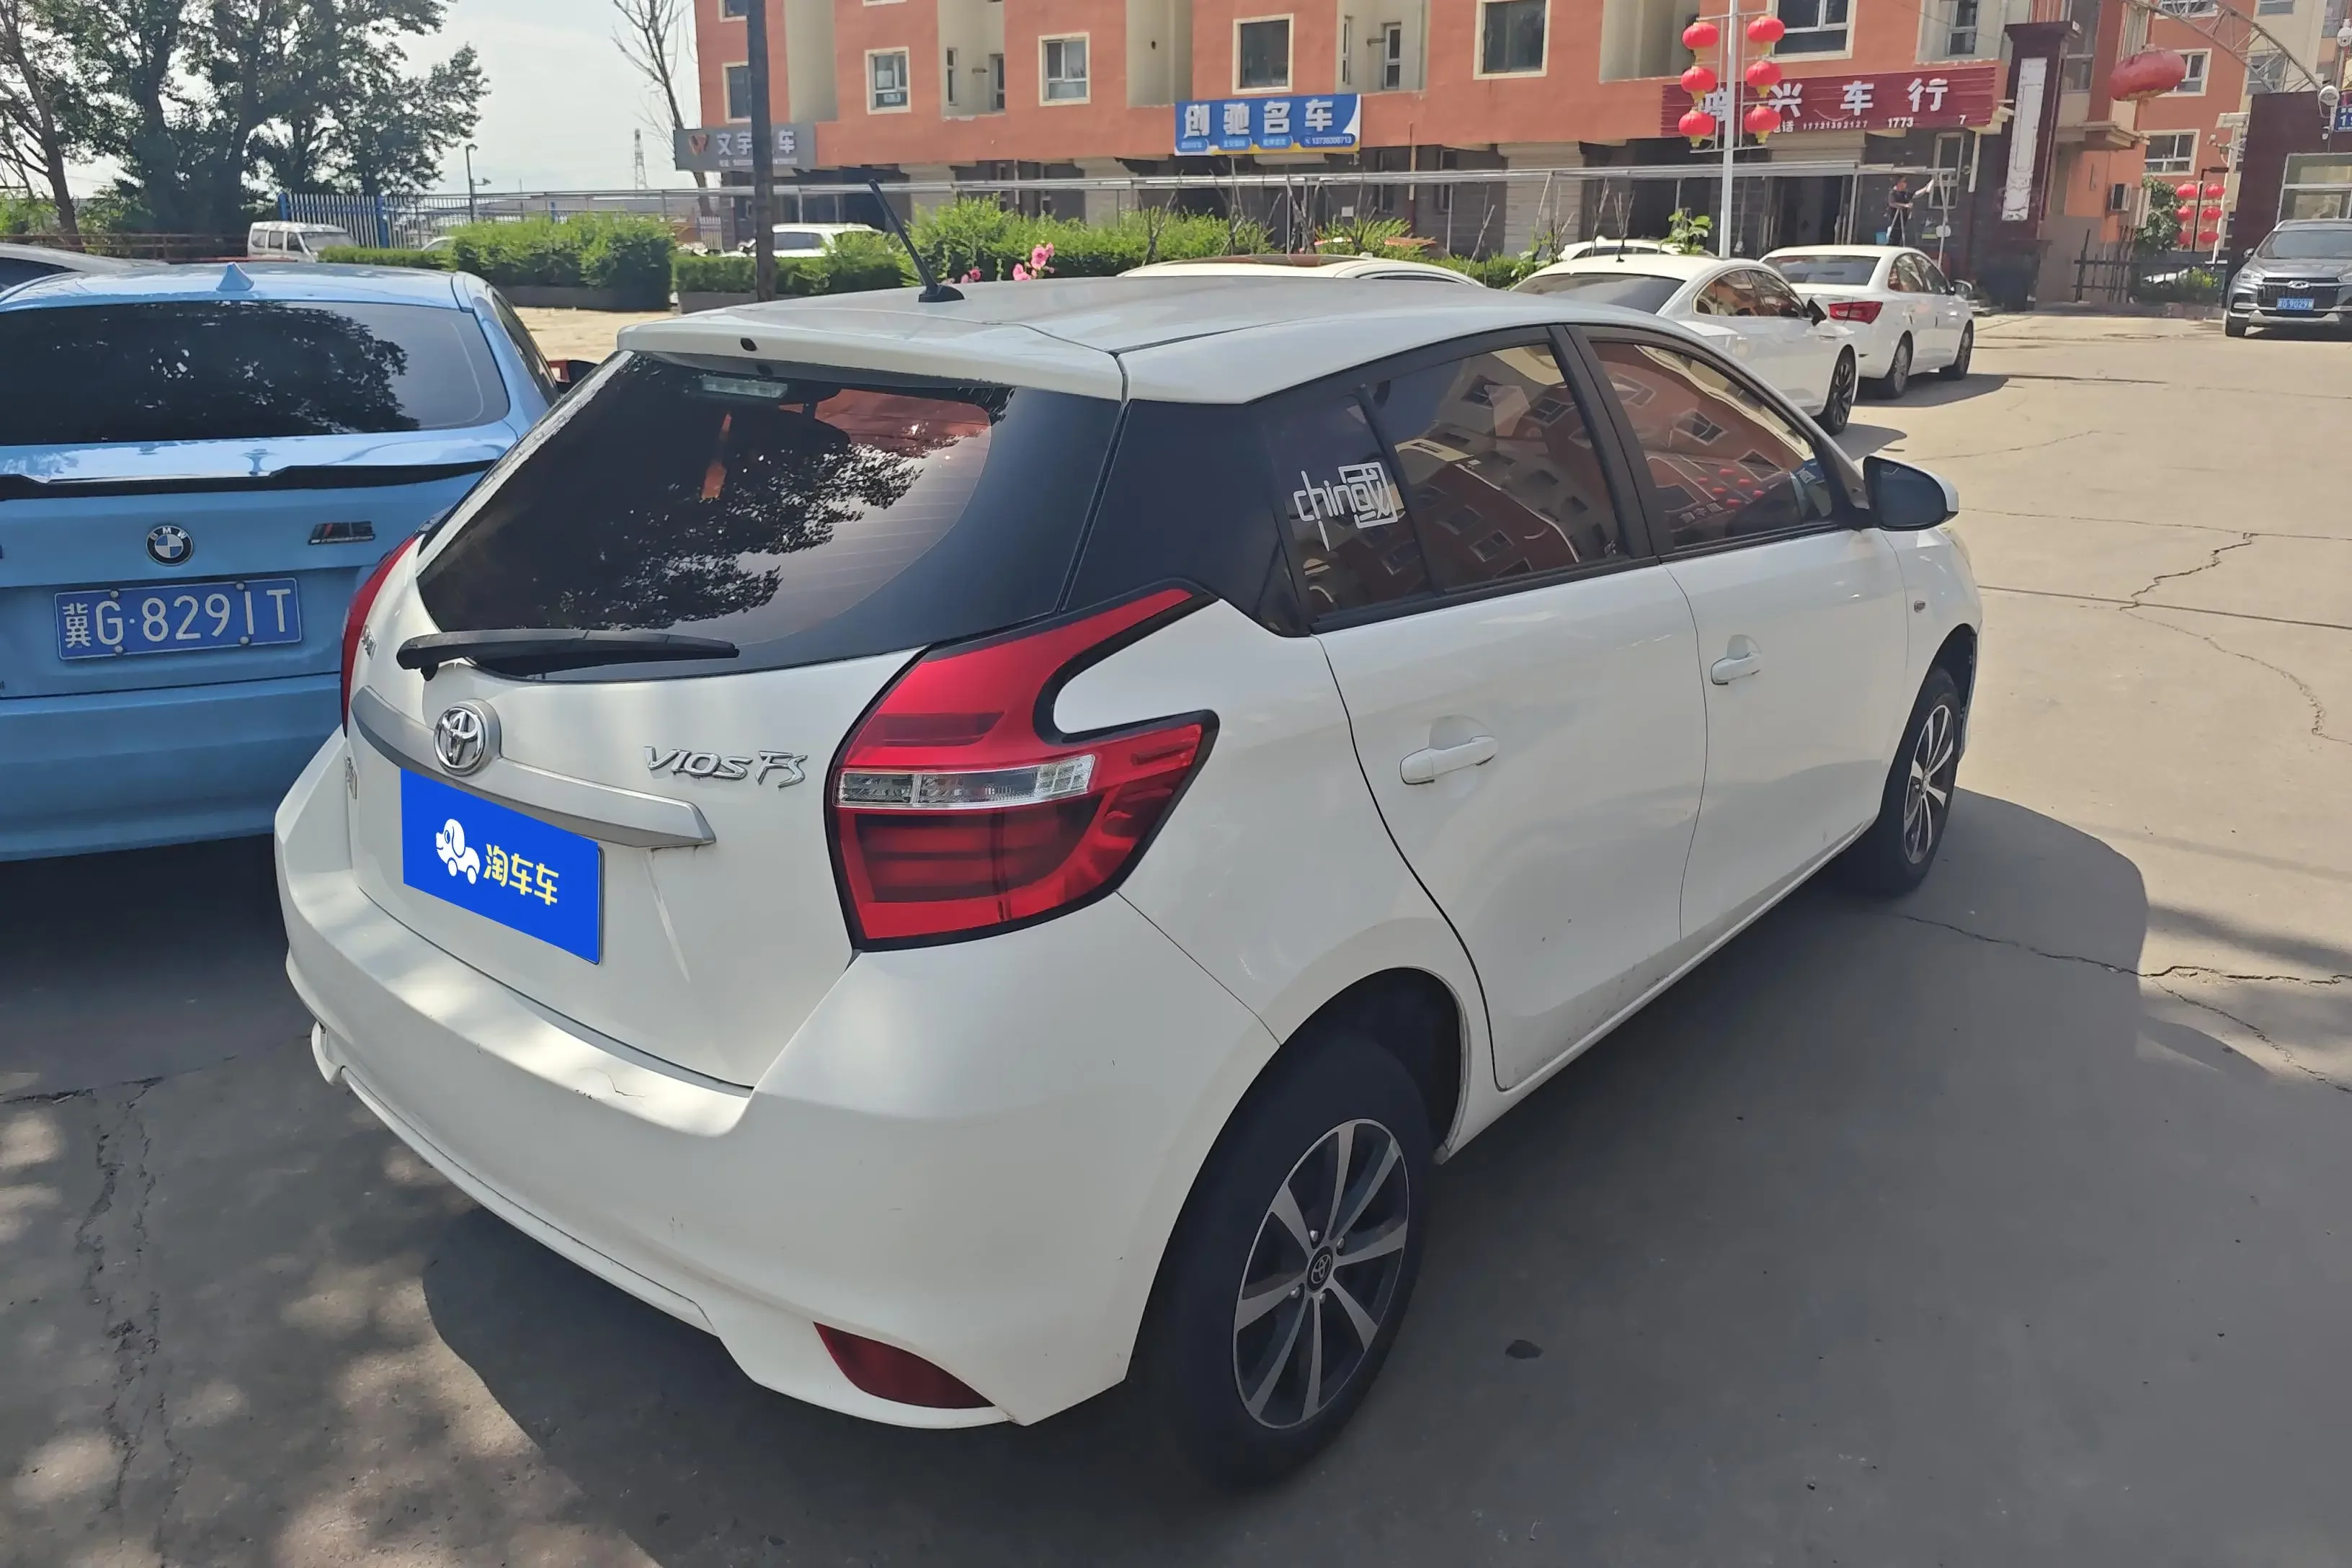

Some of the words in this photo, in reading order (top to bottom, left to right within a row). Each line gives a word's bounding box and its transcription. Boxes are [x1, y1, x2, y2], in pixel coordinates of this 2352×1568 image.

[1184, 99, 1333, 138] 创驰名车
[1887, 117, 1914, 128] 1773
[1959, 115, 1966, 125] 7
[717, 129, 795, 156] 文宇车
[643, 746, 754, 780] VIOS
